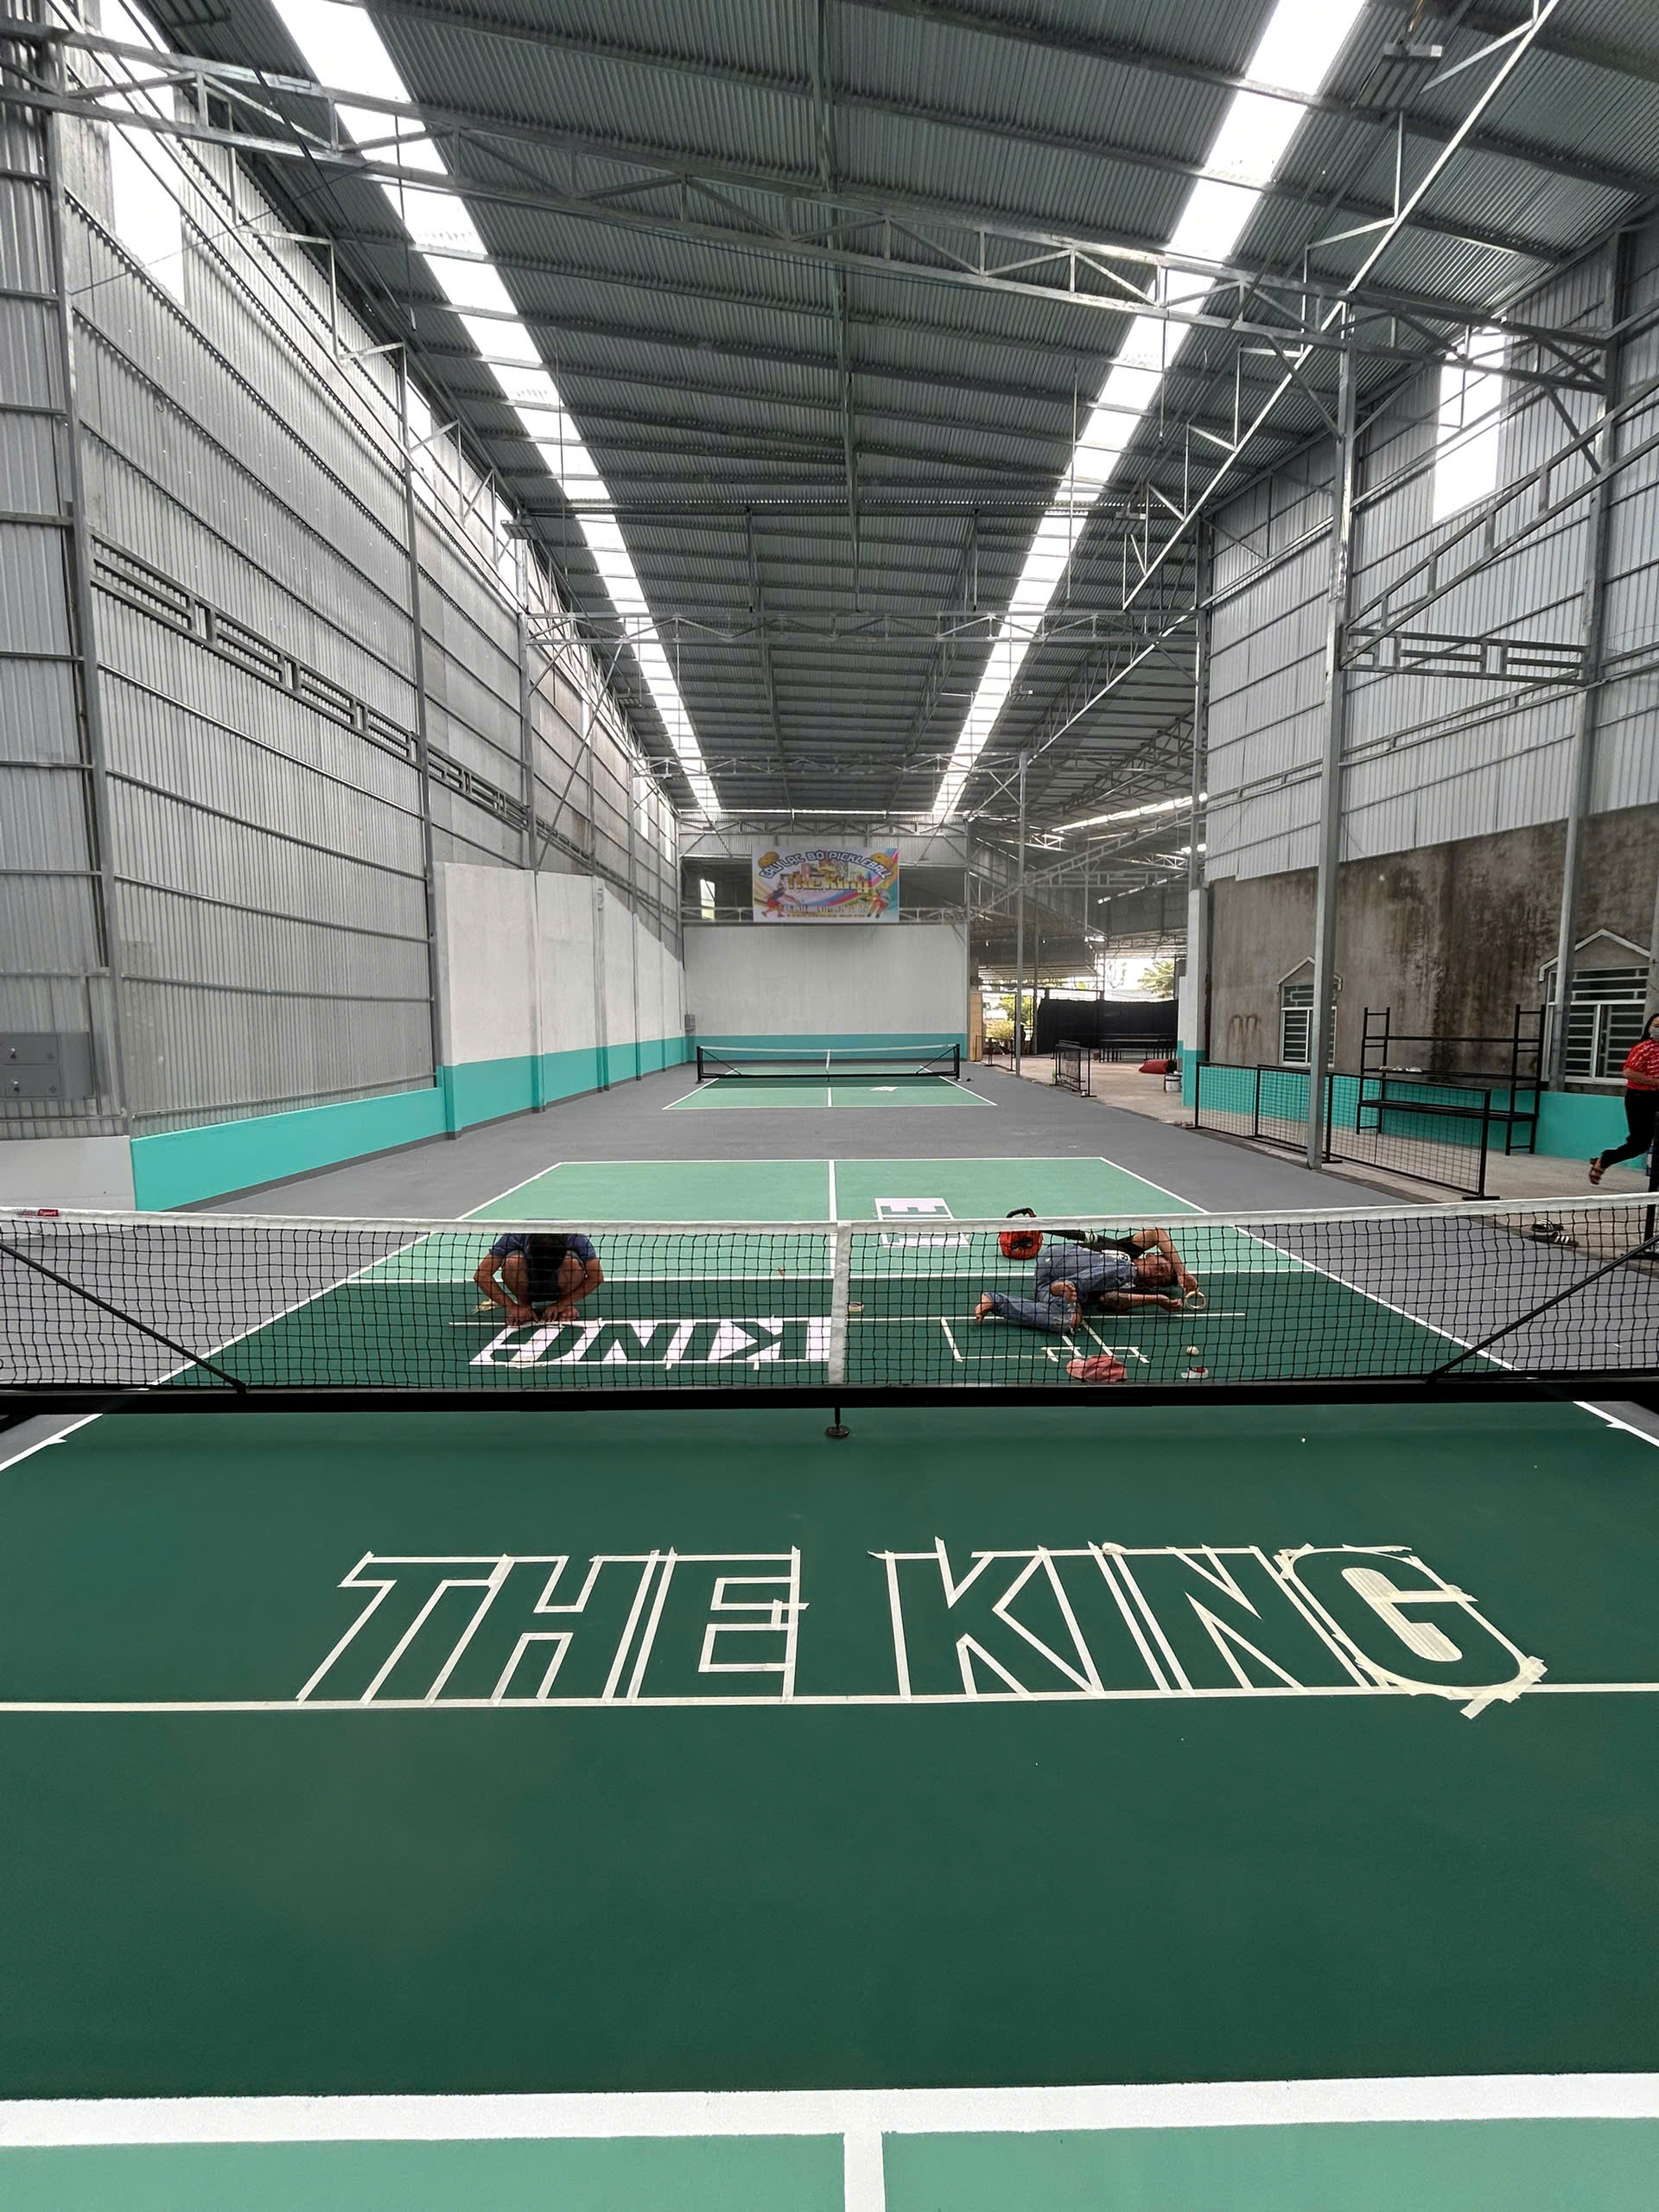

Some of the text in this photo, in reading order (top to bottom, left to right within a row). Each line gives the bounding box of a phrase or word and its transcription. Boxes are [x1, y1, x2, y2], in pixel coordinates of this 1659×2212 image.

[829, 850, 893, 880] PICKLEBALL
[470, 1319, 812, 1363] KING
[294, 1538, 1548, 1714] THE KING
